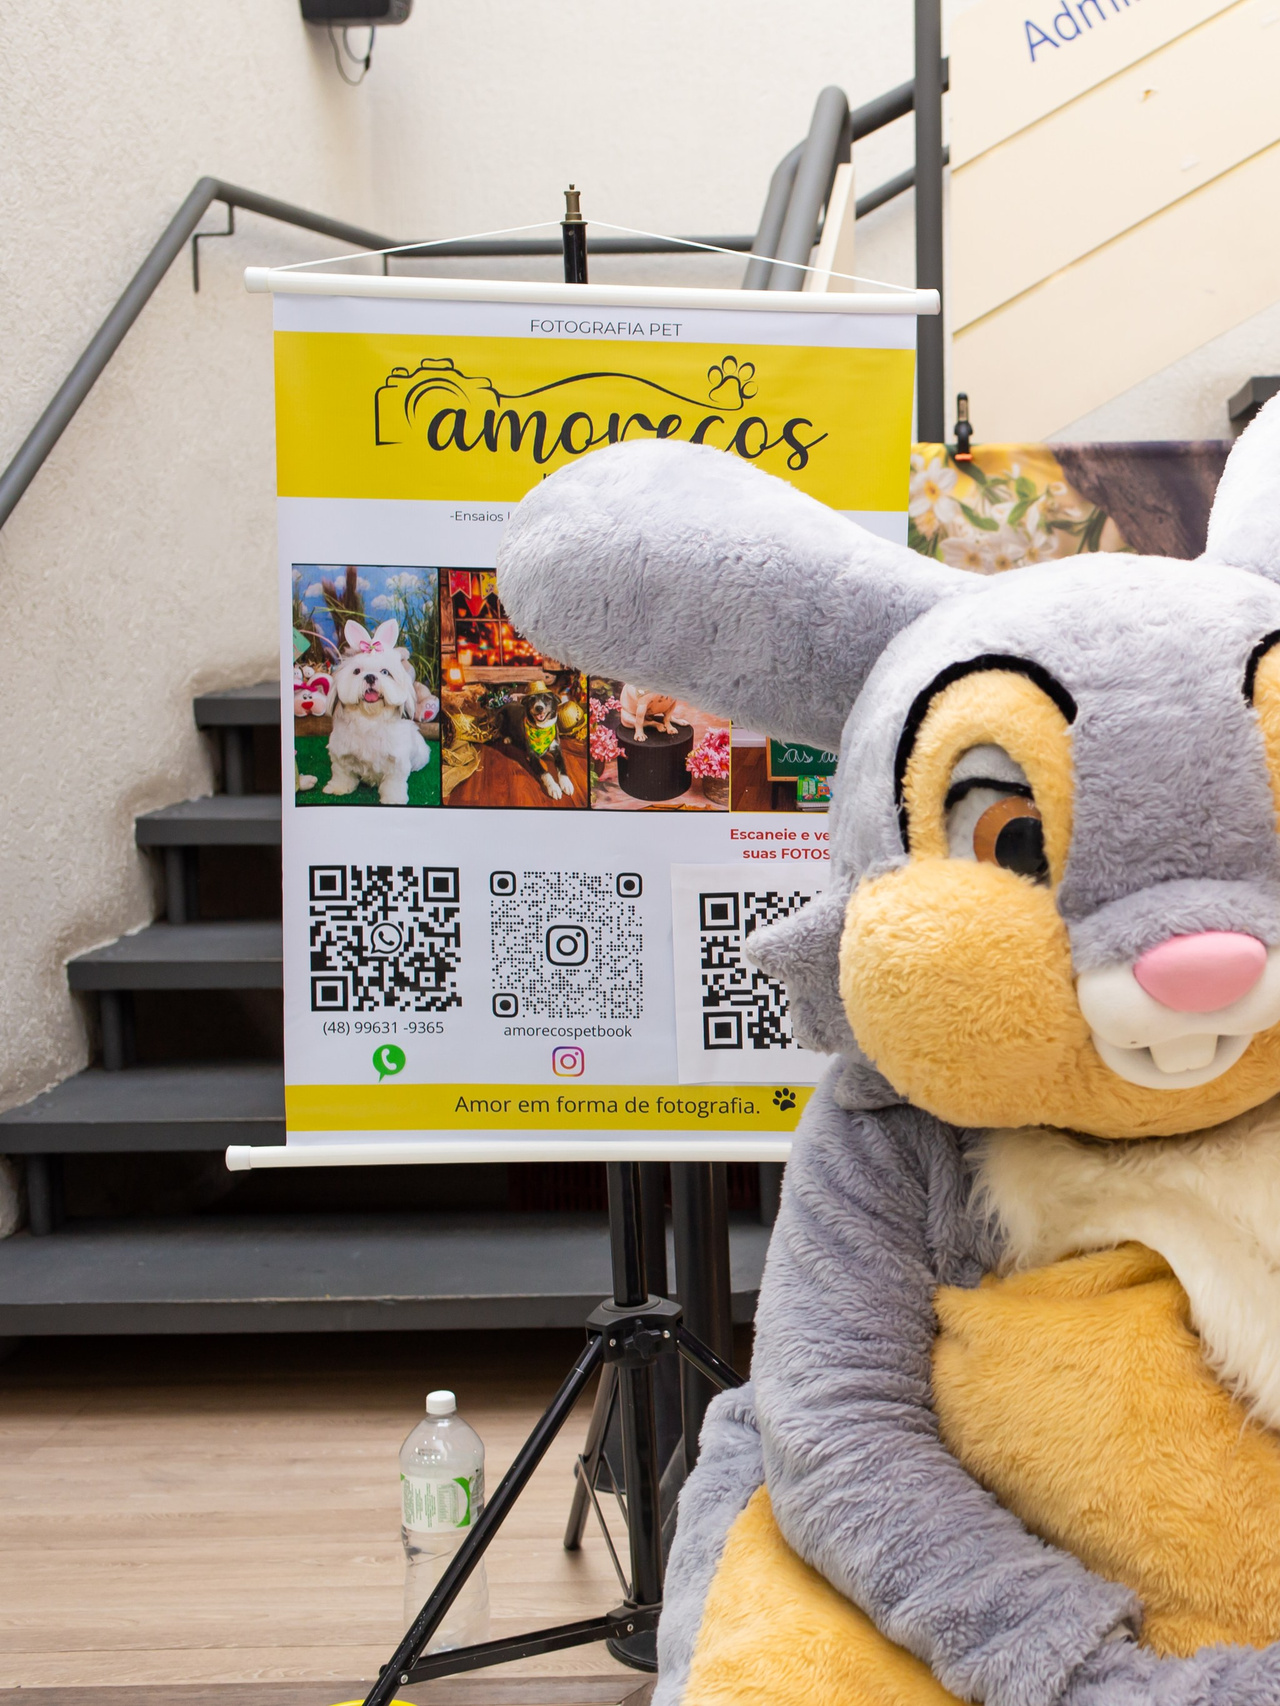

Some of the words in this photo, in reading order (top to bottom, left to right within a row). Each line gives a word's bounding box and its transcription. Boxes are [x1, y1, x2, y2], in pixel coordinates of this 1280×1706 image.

[1025, 0, 1130, 62] Adm
[530, 319, 645, 336] FOTOGRAFIA
[649, 323, 683, 337] PET
[450, 510, 504, 522] -Ensaios
[730, 828, 797, 841] Escaneie
[801, 833, 810, 841] e
[742, 850, 777, 859] suas
[781, 848, 831, 860] FOTOS
[322, 1021, 350, 1036] (48)
[354, 1021, 398, 1034] 99631
[403, 1021, 444, 1034] -9365
[503, 1024, 633, 1040] amorecospetbook
[455, 1096, 511, 1113] Amor
[518, 1100, 550, 1113] em
[556, 1095, 618, 1113] forma
[625, 1096, 650, 1114] de
[656, 1096, 761, 1118] fotografia.
